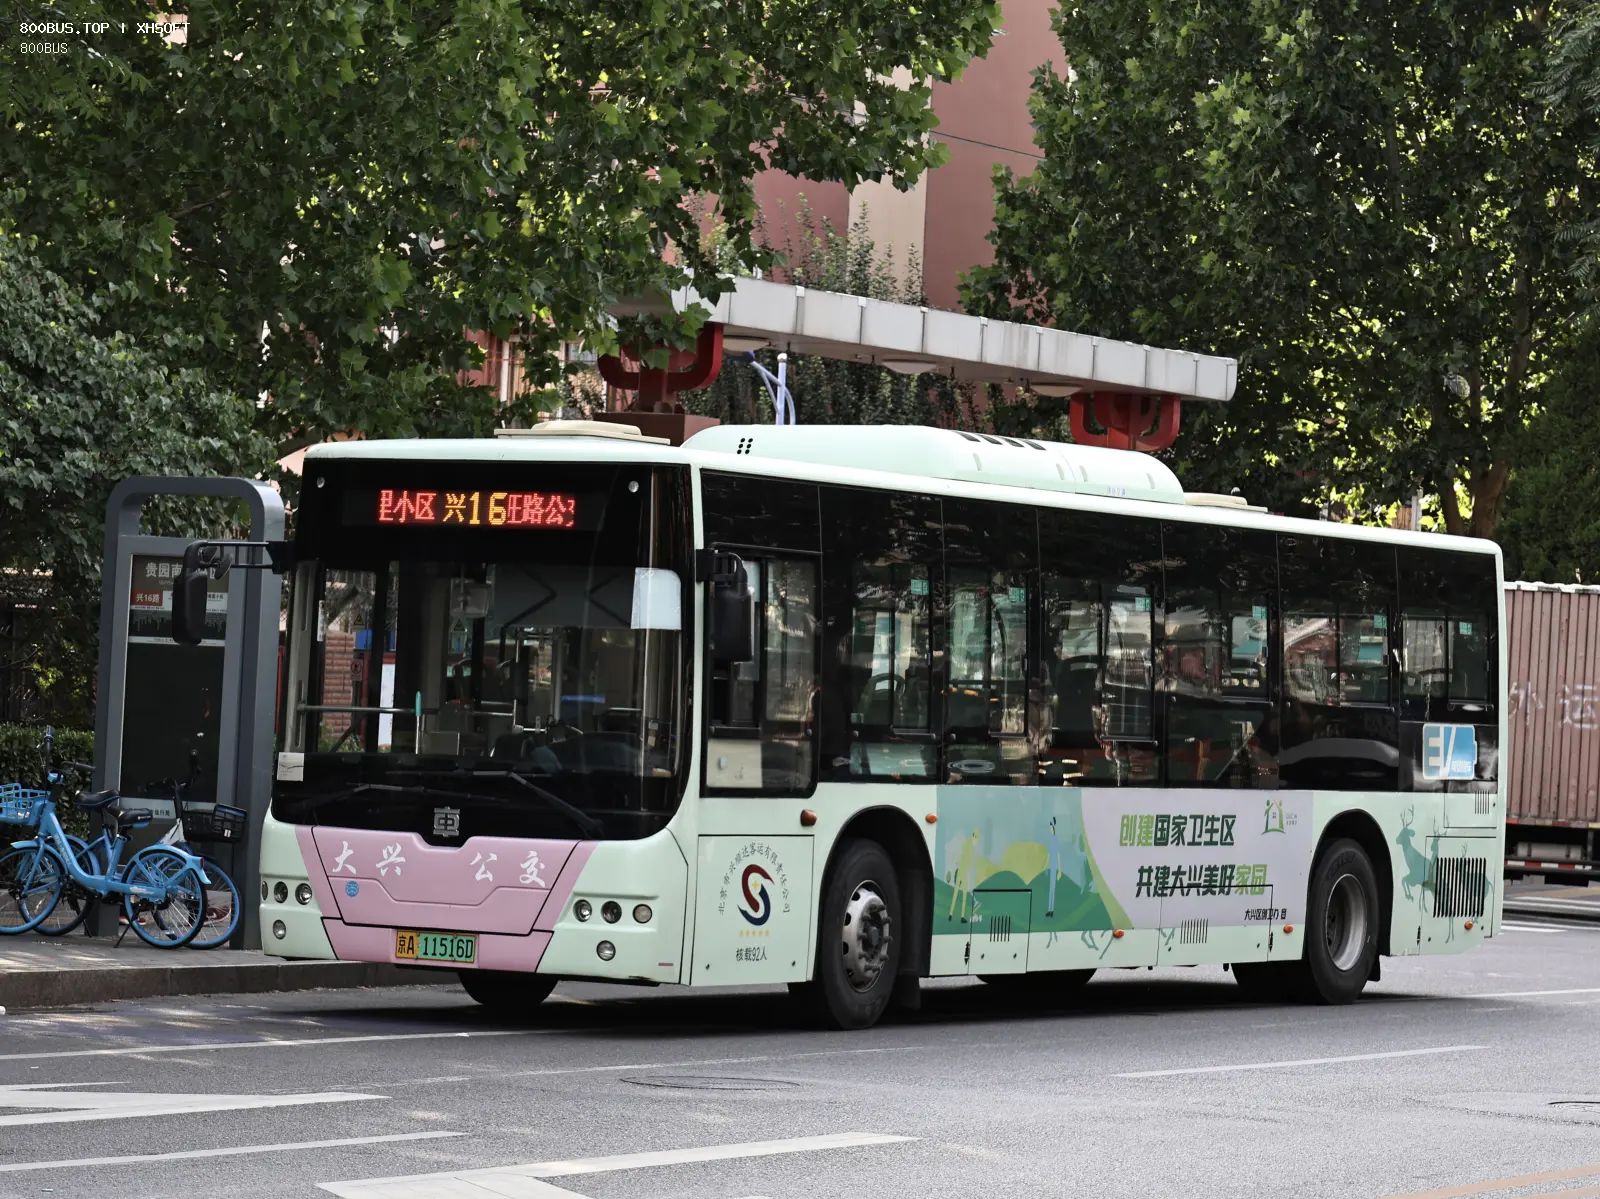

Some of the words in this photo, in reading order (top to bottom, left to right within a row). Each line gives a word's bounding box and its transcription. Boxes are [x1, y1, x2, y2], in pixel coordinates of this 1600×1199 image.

[442, 491, 508, 525] 兴16
[136, 592, 160, 604] 兴16路
[1119, 814, 1237, 847] 创建国家卫生区
[1135, 863, 1268, 898] 共建大兴美好家园
[735, 946, 768, 962] 核载92人
